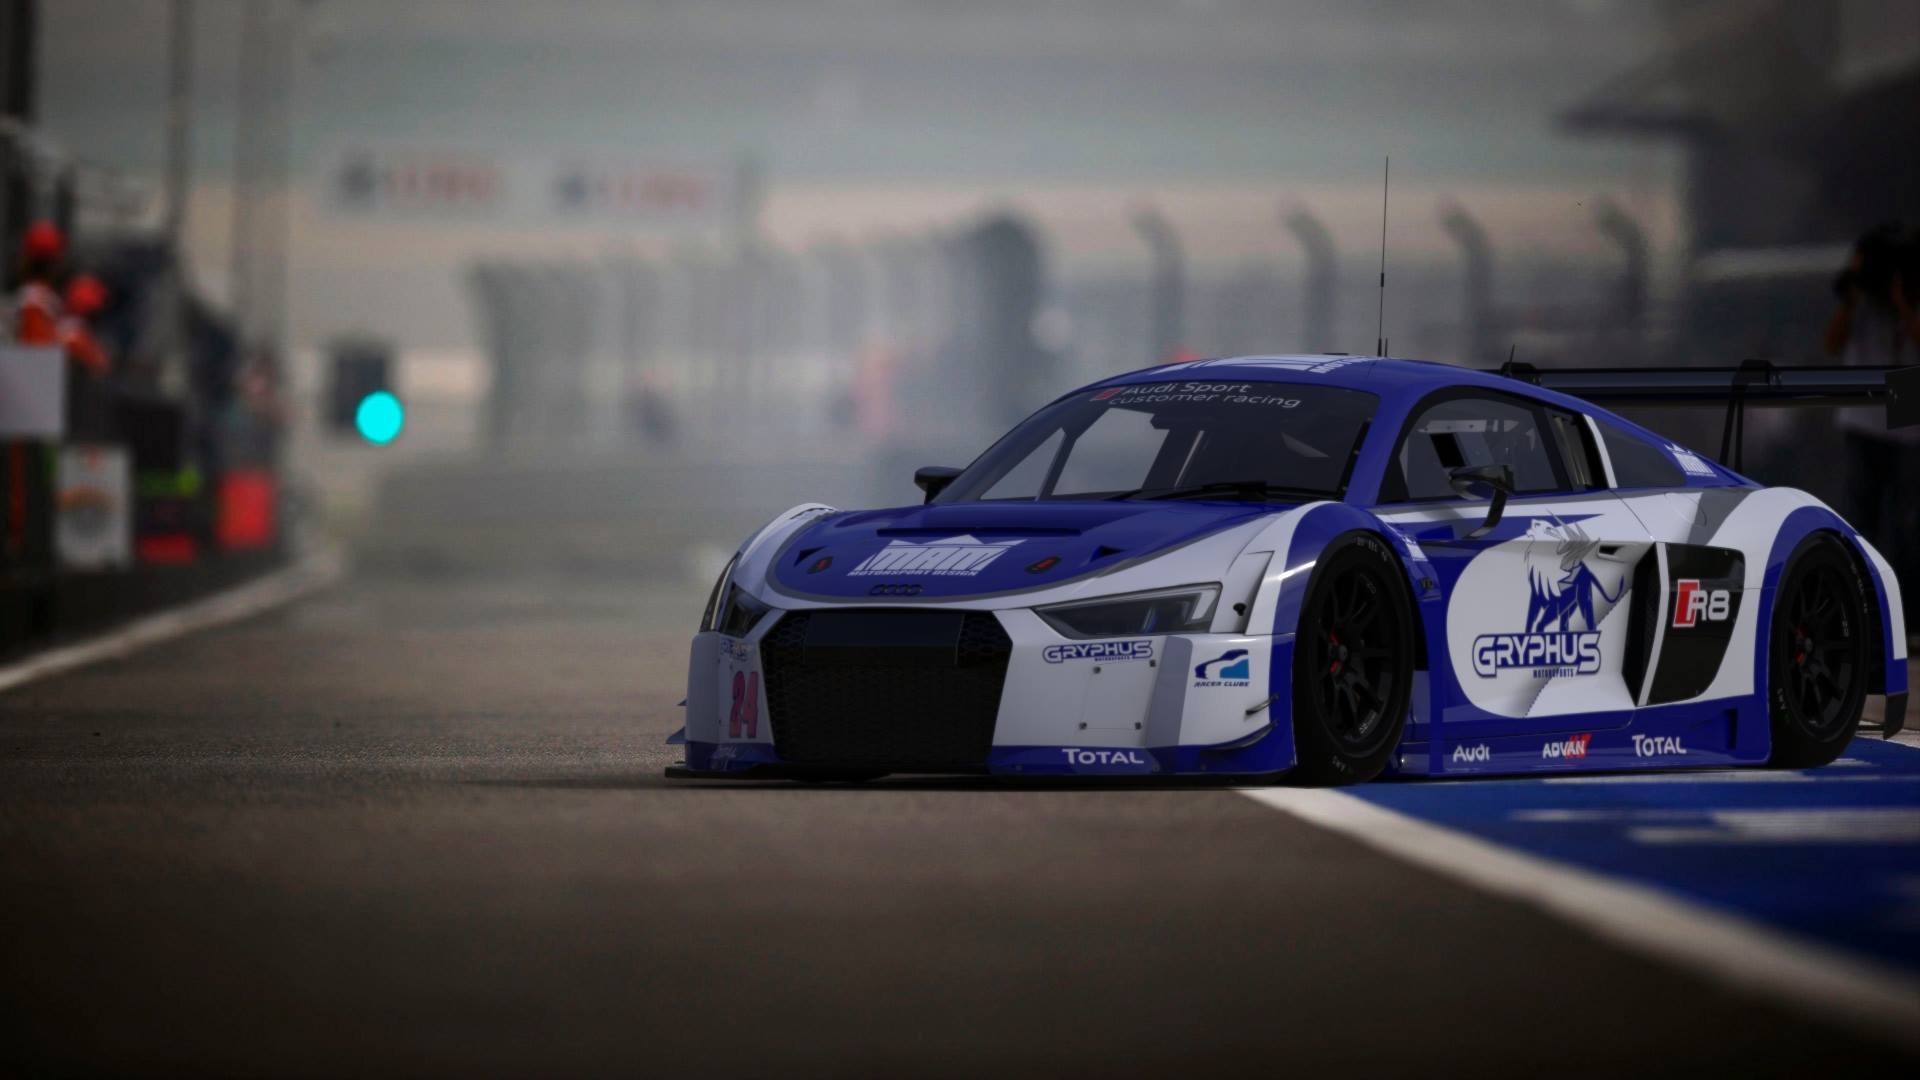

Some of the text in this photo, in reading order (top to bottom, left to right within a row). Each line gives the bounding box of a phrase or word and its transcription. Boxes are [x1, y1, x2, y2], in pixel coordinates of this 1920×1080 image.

[1123, 382, 1252, 394] Audi Sport
[1110, 393, 1302, 409] customer racing
[1686, 589, 1730, 621] R8
[1042, 640, 1153, 664] GRYPHUS
[1473, 630, 1601, 678] GRYPHUS
[1453, 744, 1490, 762] Audi
[1542, 740, 1586, 758] ADVAN
[1632, 734, 1687, 757] TOTAL
[1062, 749, 1144, 764] TOTAL
